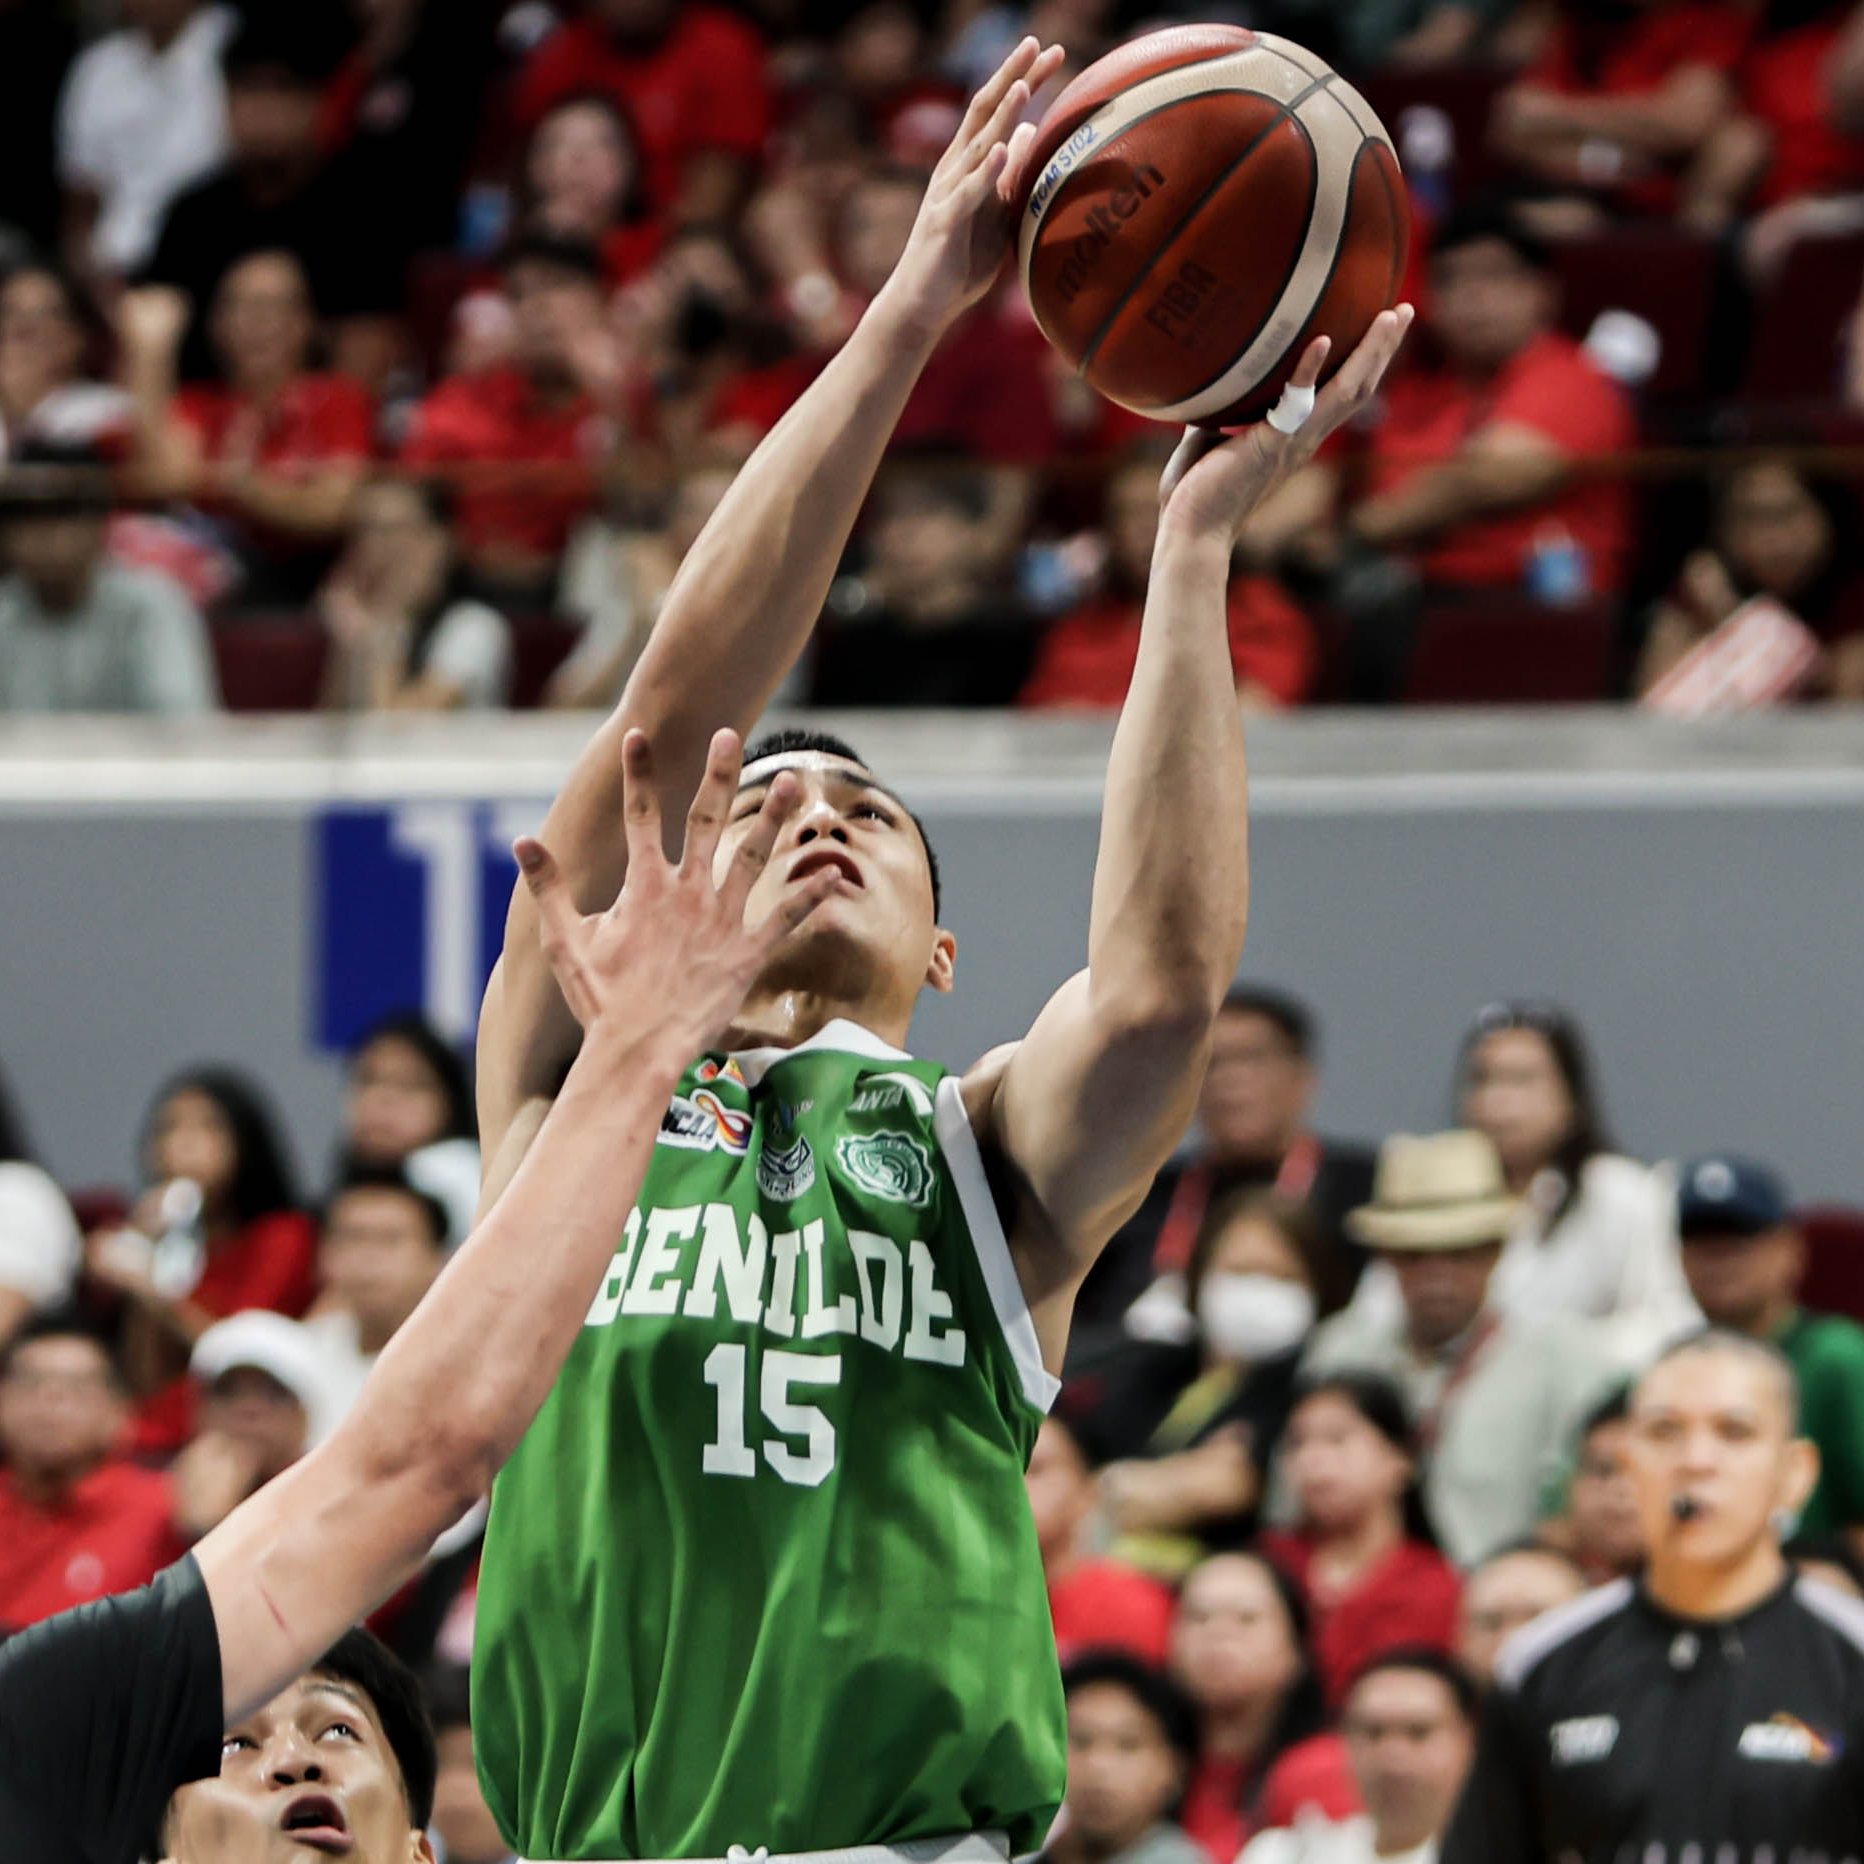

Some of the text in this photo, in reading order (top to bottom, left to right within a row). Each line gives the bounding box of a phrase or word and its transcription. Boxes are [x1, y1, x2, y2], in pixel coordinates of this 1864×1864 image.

[1054, 163, 1166, 303] molten
[1146, 257, 1217, 339] FIBA
[848, 1085, 905, 1112] ANTA
[583, 1203, 967, 1368] BENILDE
[702, 1342, 842, 1487] 15
